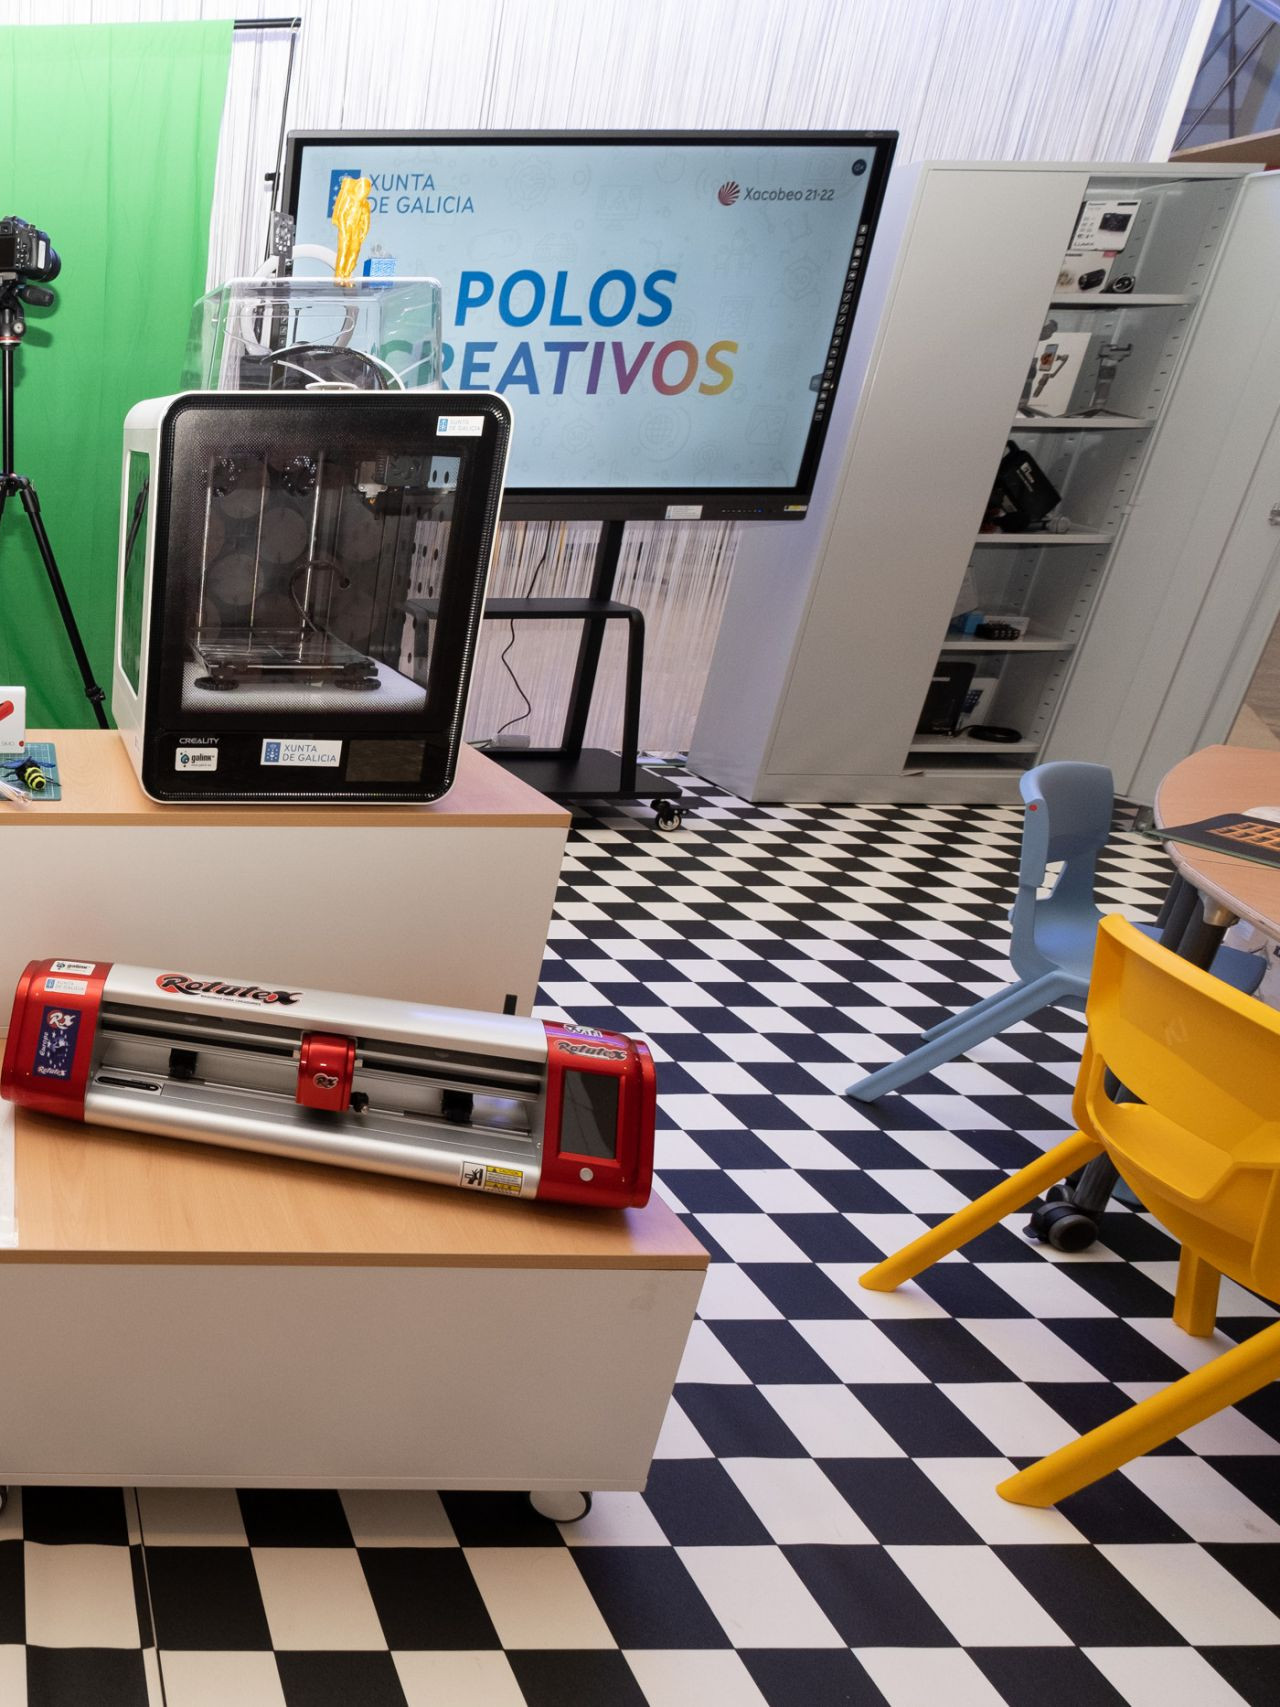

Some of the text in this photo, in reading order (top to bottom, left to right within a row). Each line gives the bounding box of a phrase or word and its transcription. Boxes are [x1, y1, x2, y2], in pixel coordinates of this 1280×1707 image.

[369, 174, 435, 191] XUNTA
[743, 187, 803, 201] Xacobeo
[396, 196, 474, 213] GALICIA
[454, 269, 677, 327] POLOS
[284, 744, 318, 753] XUNTA
[297, 754, 337, 762] GALICIA
